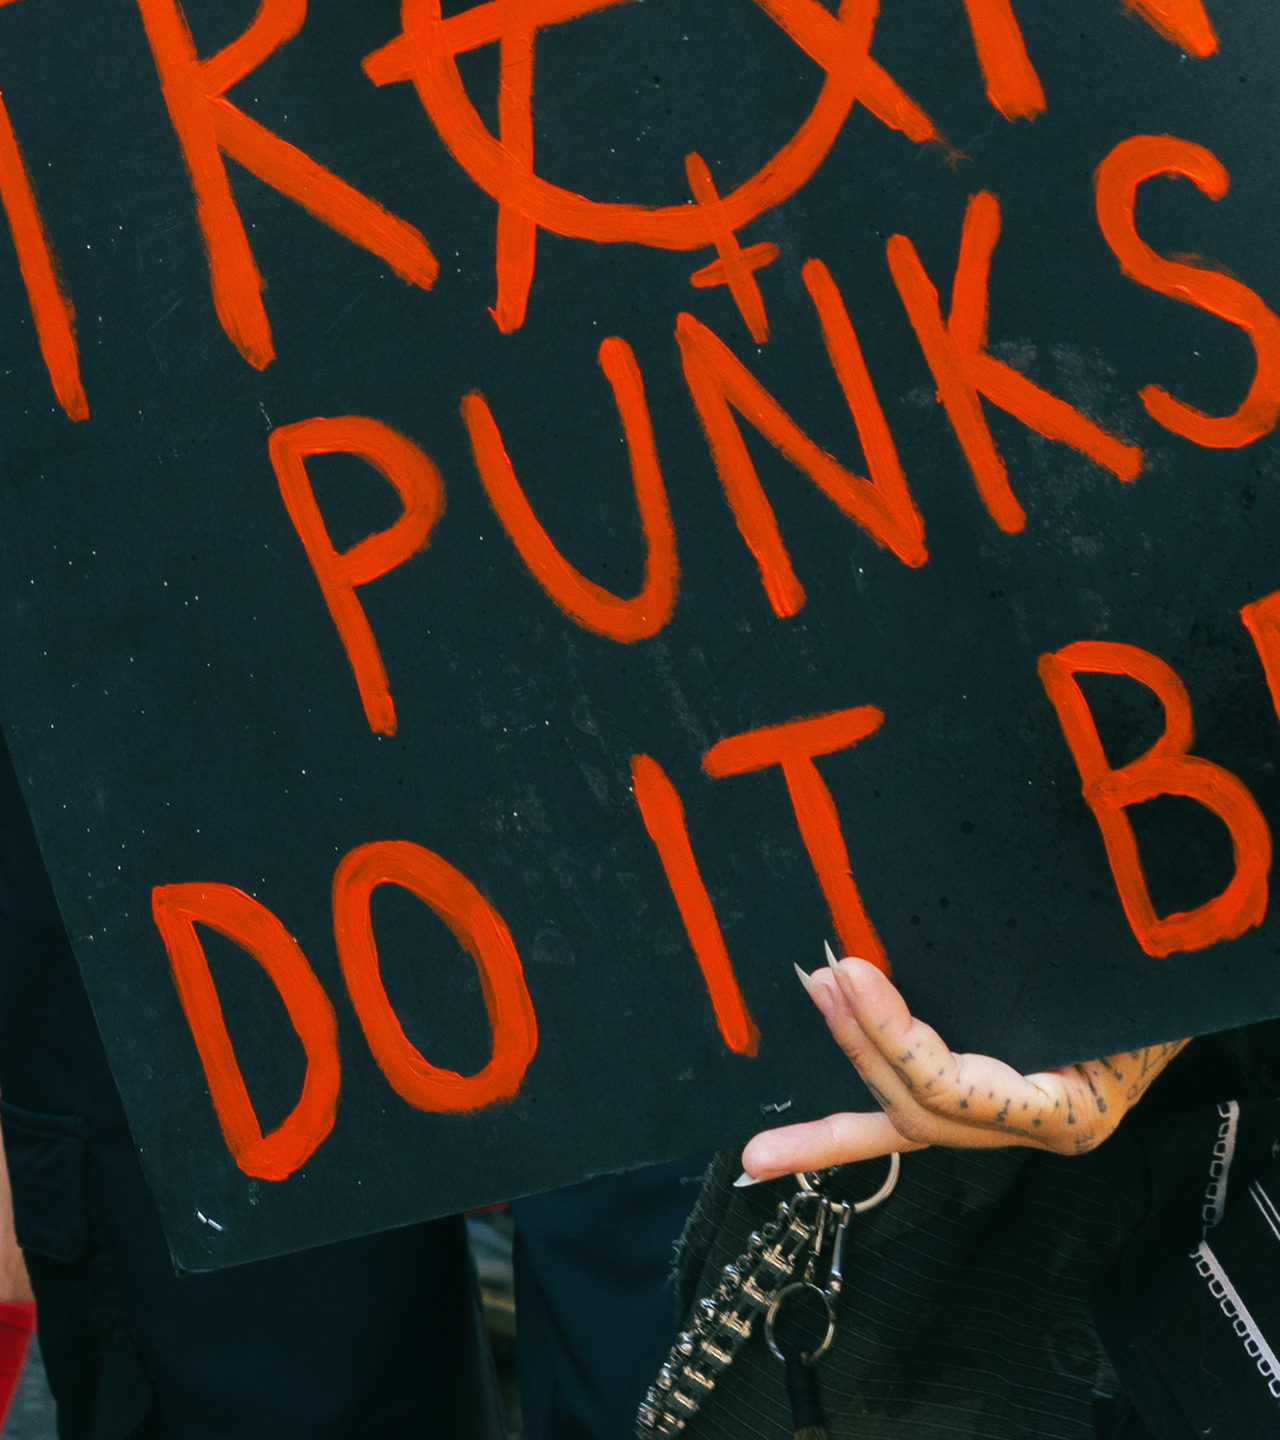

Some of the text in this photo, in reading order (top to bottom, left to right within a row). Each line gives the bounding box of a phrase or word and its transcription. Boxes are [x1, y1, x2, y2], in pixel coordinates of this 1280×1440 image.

[267, 132, 1280, 736] PUNKS
[150, 839, 538, 1184] DO
[630, 705, 888, 1057] IT
